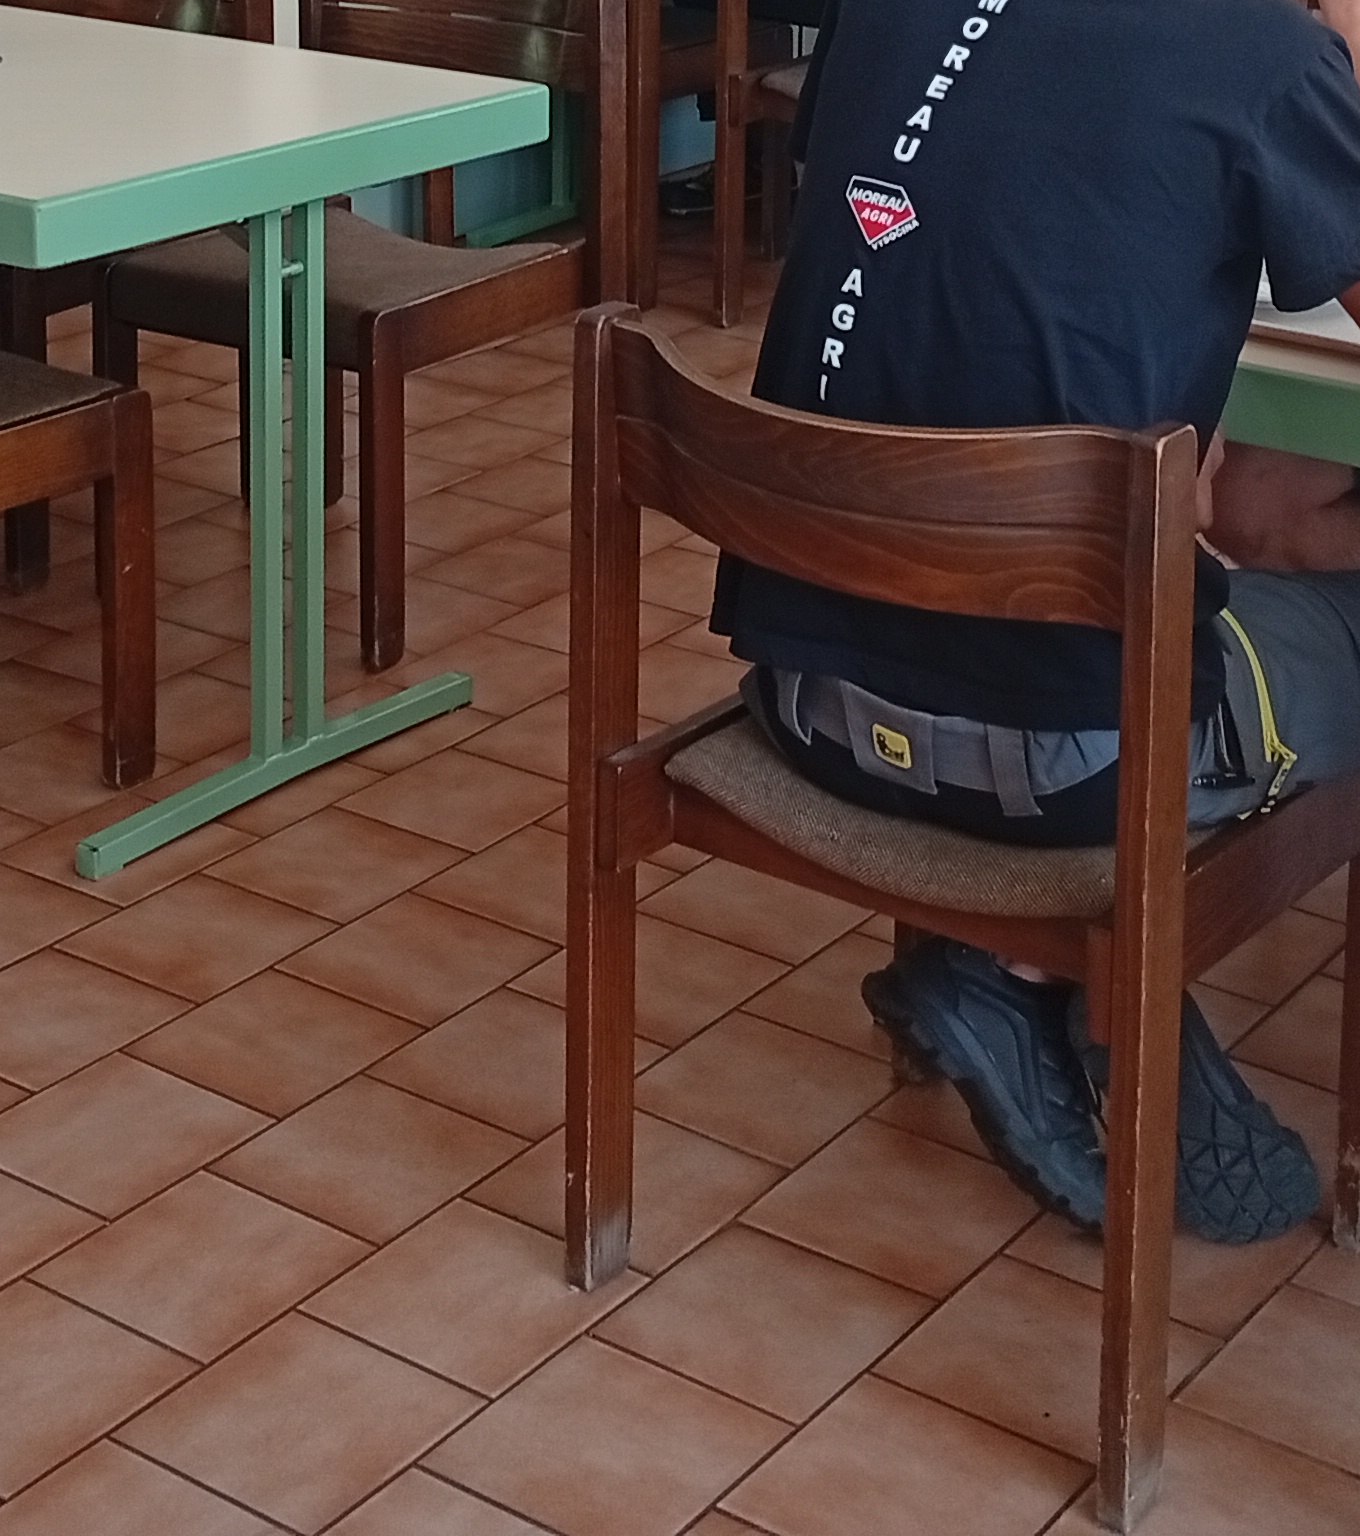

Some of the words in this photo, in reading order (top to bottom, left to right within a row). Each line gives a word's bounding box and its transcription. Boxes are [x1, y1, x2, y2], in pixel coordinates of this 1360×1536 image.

[850, 187, 908, 214] MOREAU
[860, 207, 895, 227] AGRI
[818, 267, 866, 403] AGRI
